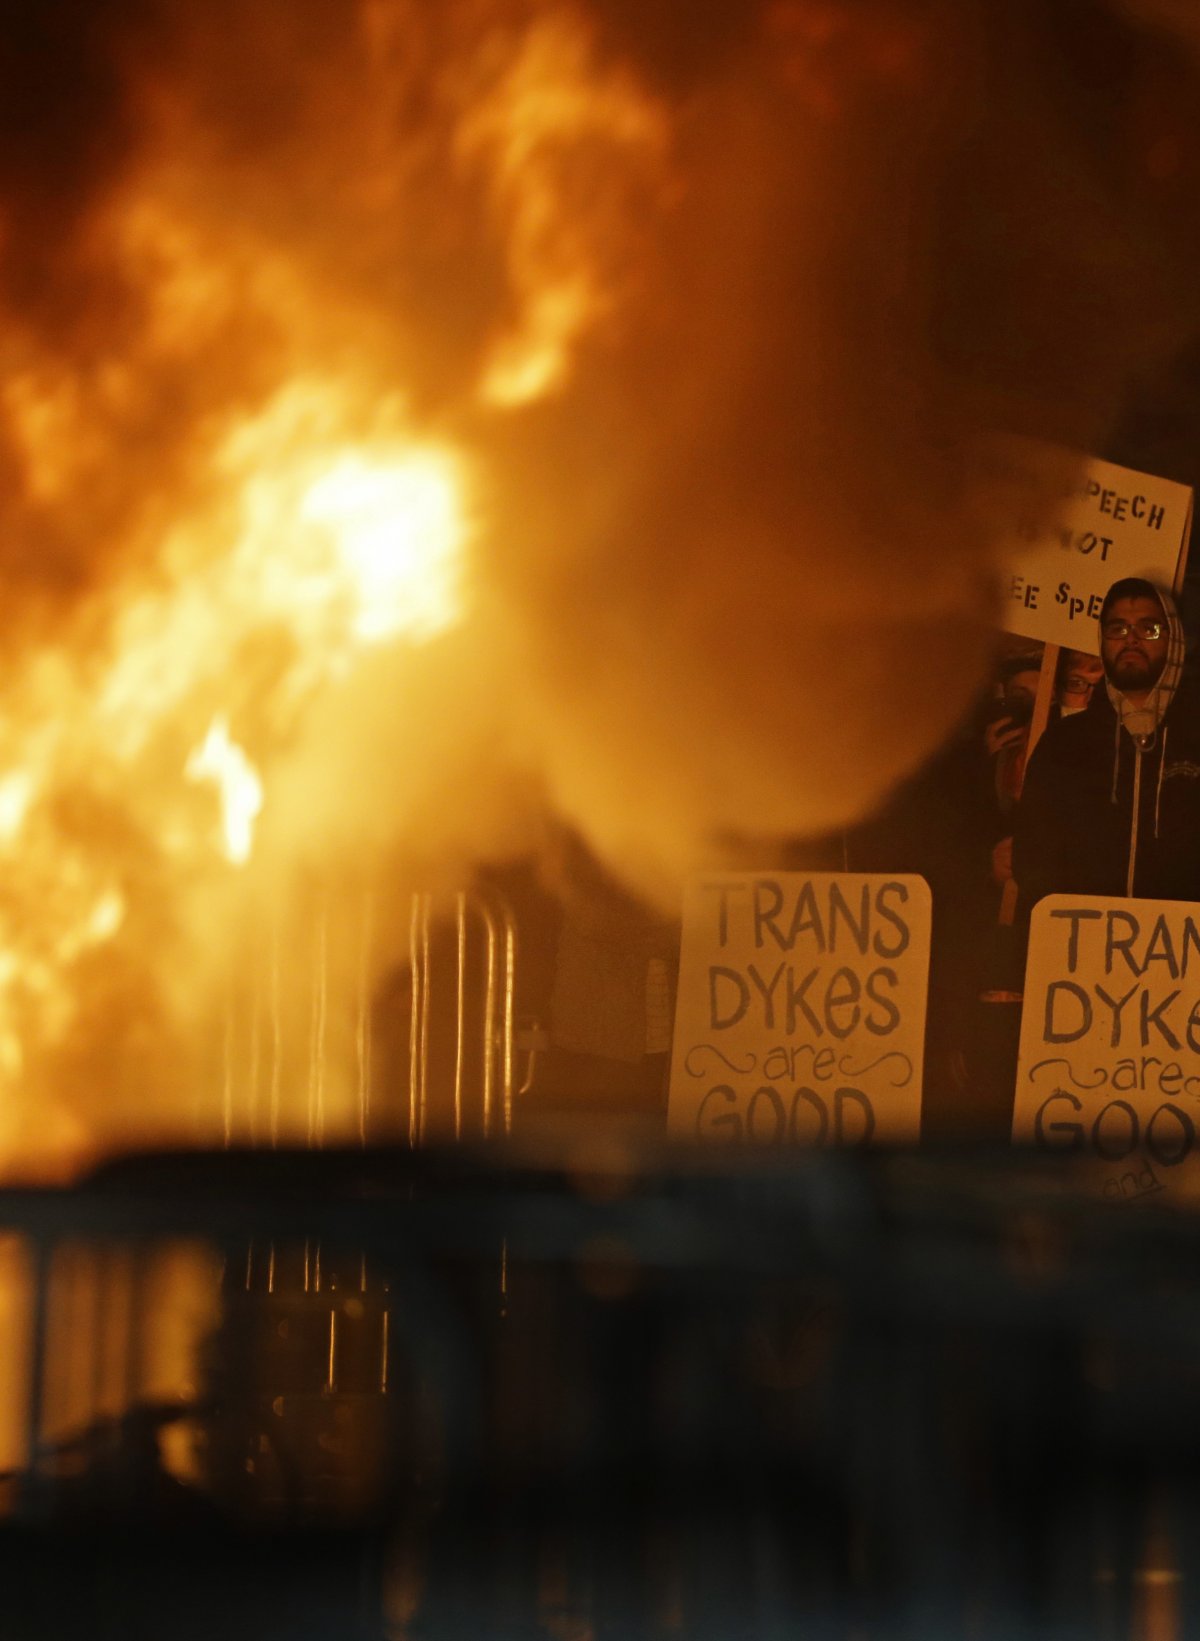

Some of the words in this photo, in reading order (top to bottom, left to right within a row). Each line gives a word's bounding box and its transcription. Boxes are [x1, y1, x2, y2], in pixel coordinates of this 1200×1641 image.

[701, 881, 911, 959] TRANS
[763, 1043, 837, 1082] are
[1112, 1054, 1183, 1095] are
